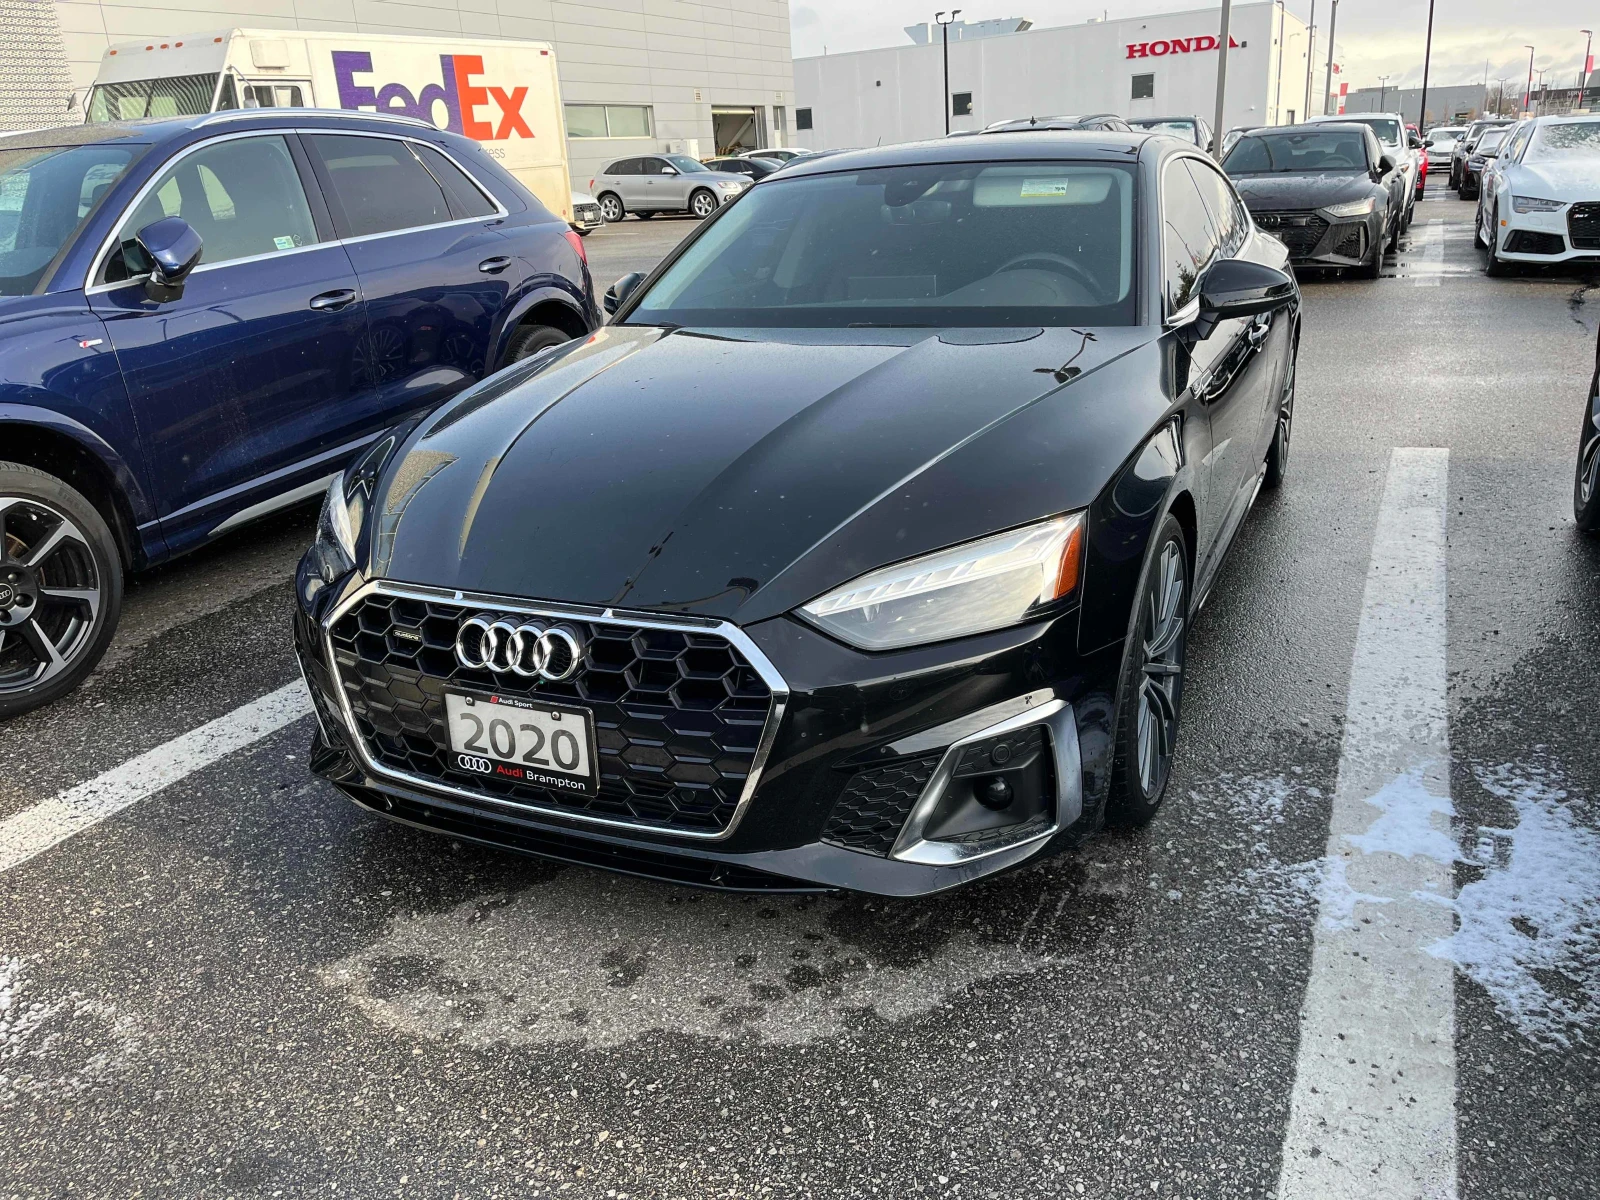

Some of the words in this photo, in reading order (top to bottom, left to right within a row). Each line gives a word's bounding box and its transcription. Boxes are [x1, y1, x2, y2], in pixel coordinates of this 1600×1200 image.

[1126, 35, 1239, 59] HONDA
[331, 50, 535, 140] FedEx
[498, 697, 513, 705] Audi
[514, 700, 533, 709] Sport
[460, 712, 580, 771] 2020
[496, 764, 523, 778] Audi
[526, 770, 586, 791] Brampton
